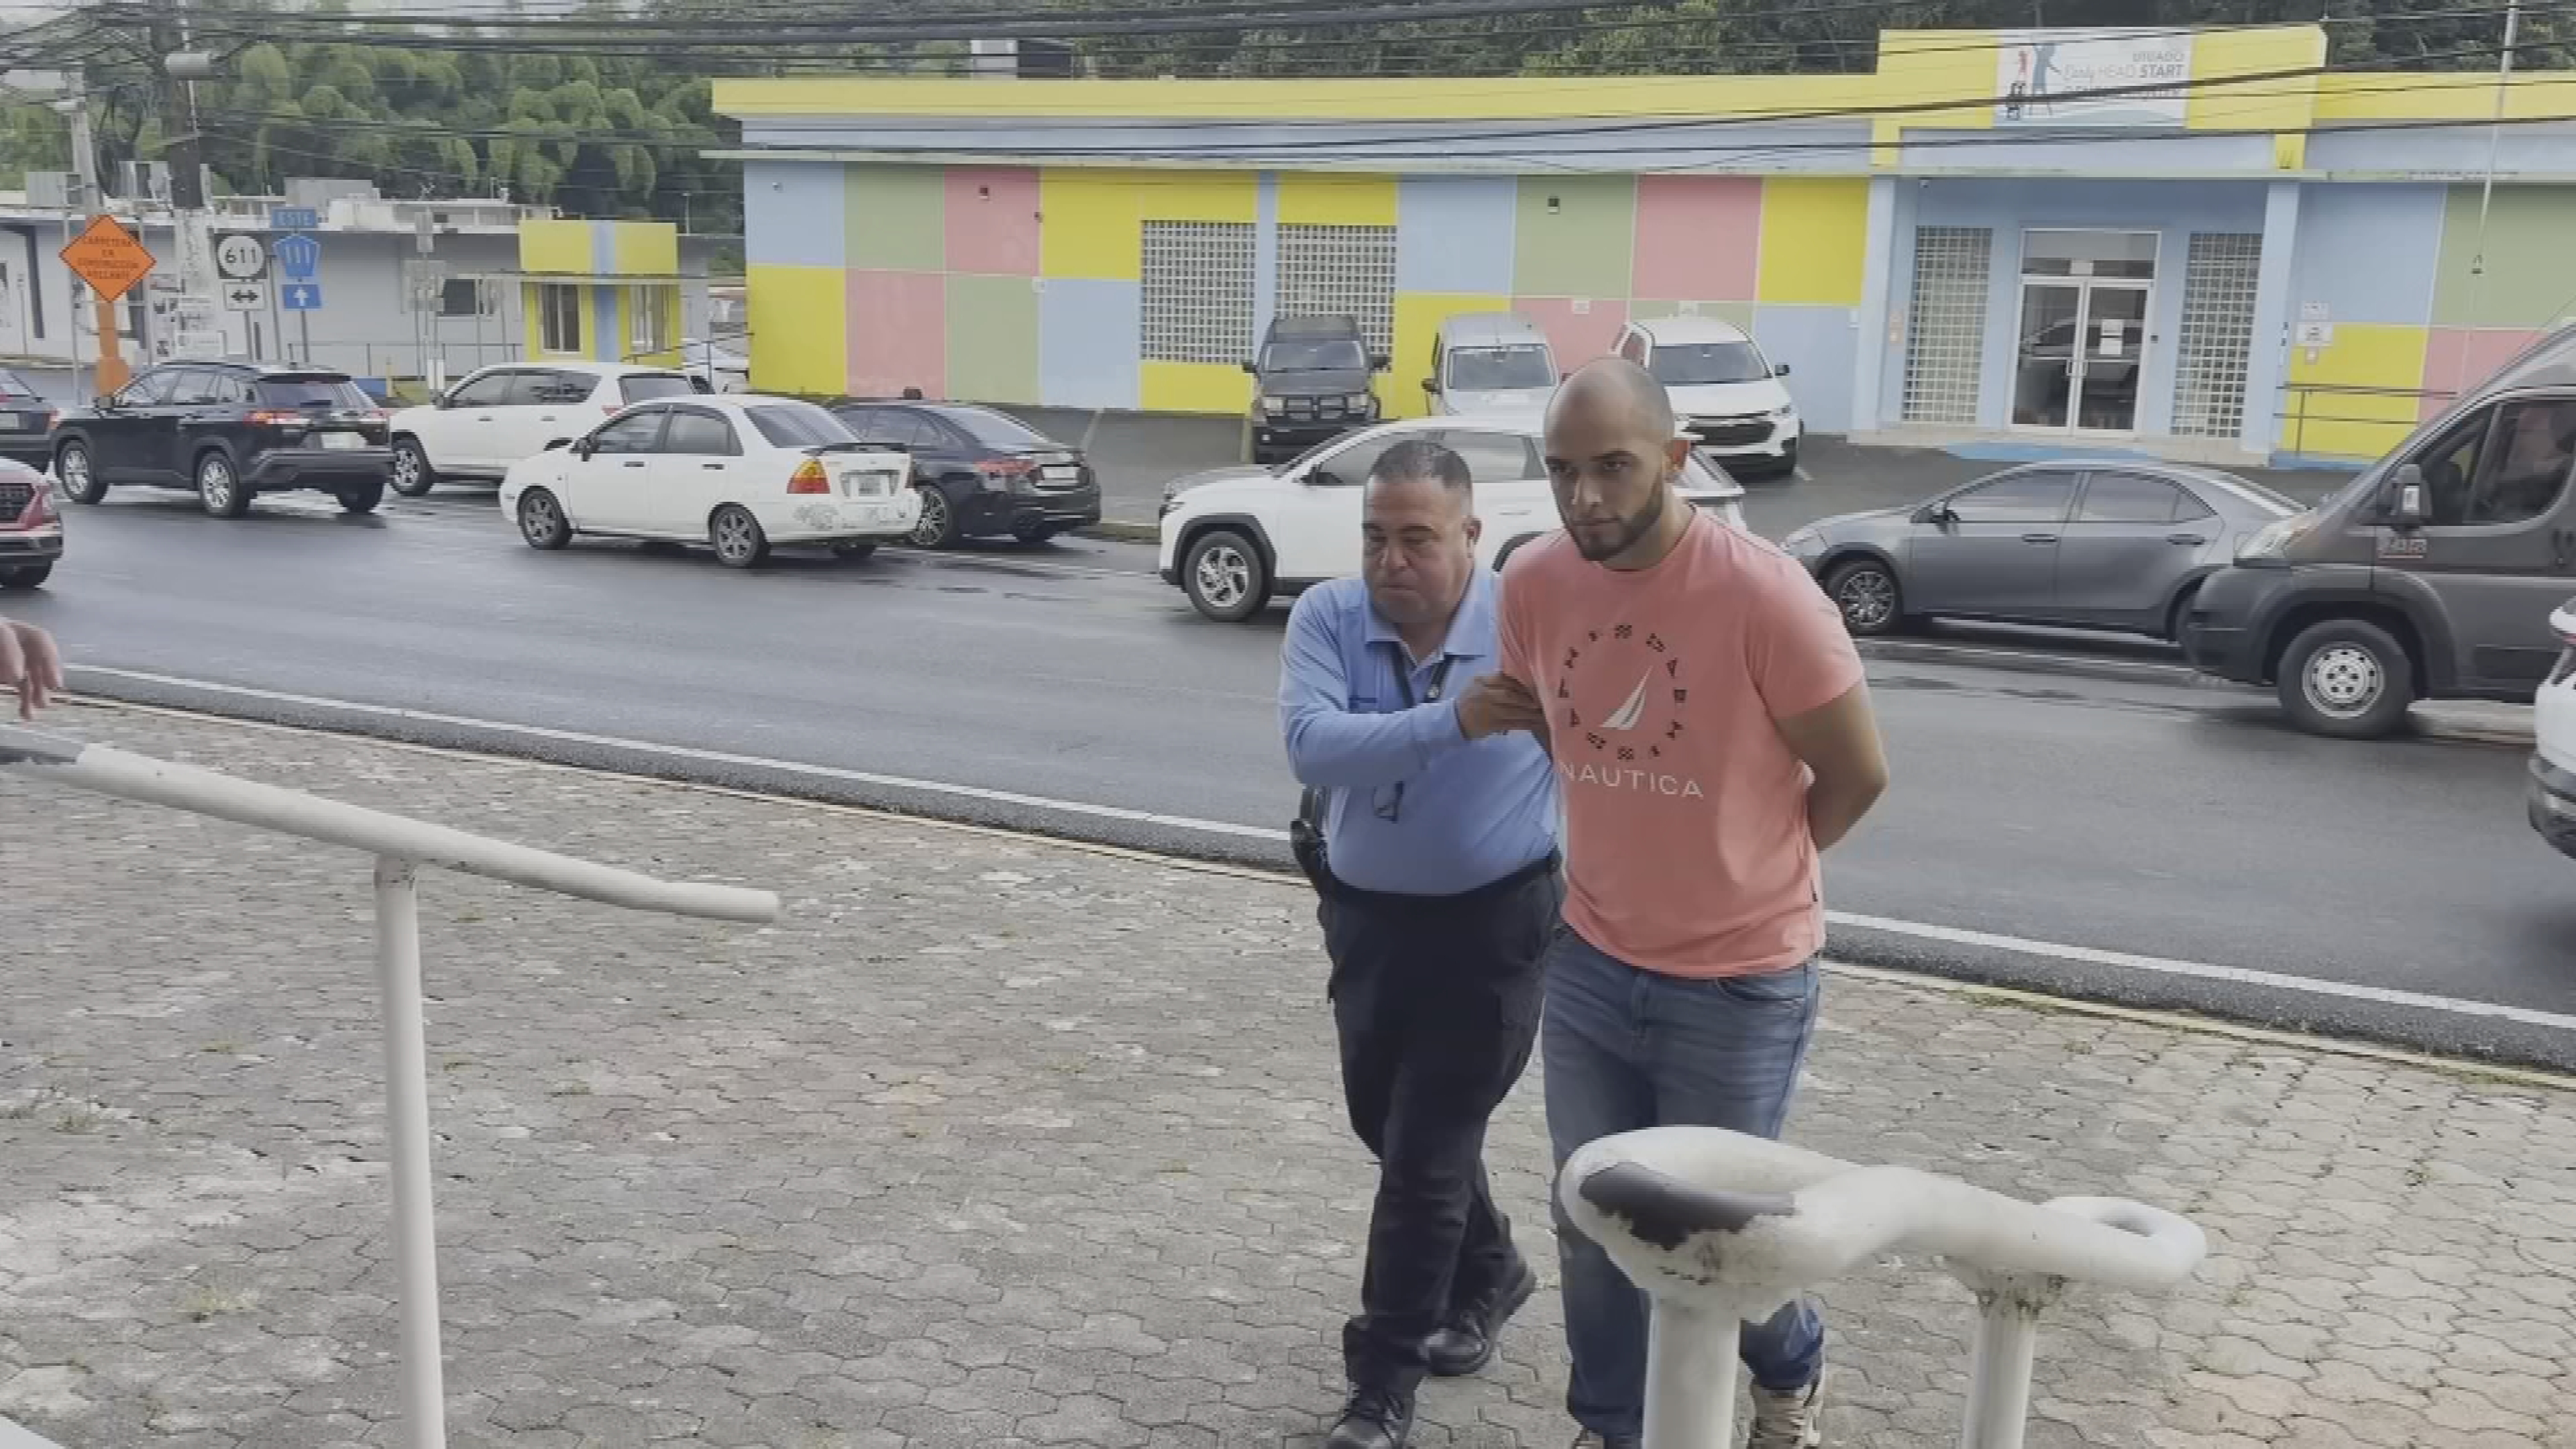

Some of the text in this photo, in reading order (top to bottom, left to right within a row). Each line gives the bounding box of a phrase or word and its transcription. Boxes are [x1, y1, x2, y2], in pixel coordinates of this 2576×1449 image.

[2139, 64, 2185, 78] START
[278, 211, 311, 226] ESTE
[225, 246, 256, 264] 611
[285, 244, 311, 264] 111
[1558, 761, 1704, 799] NAUTICA
